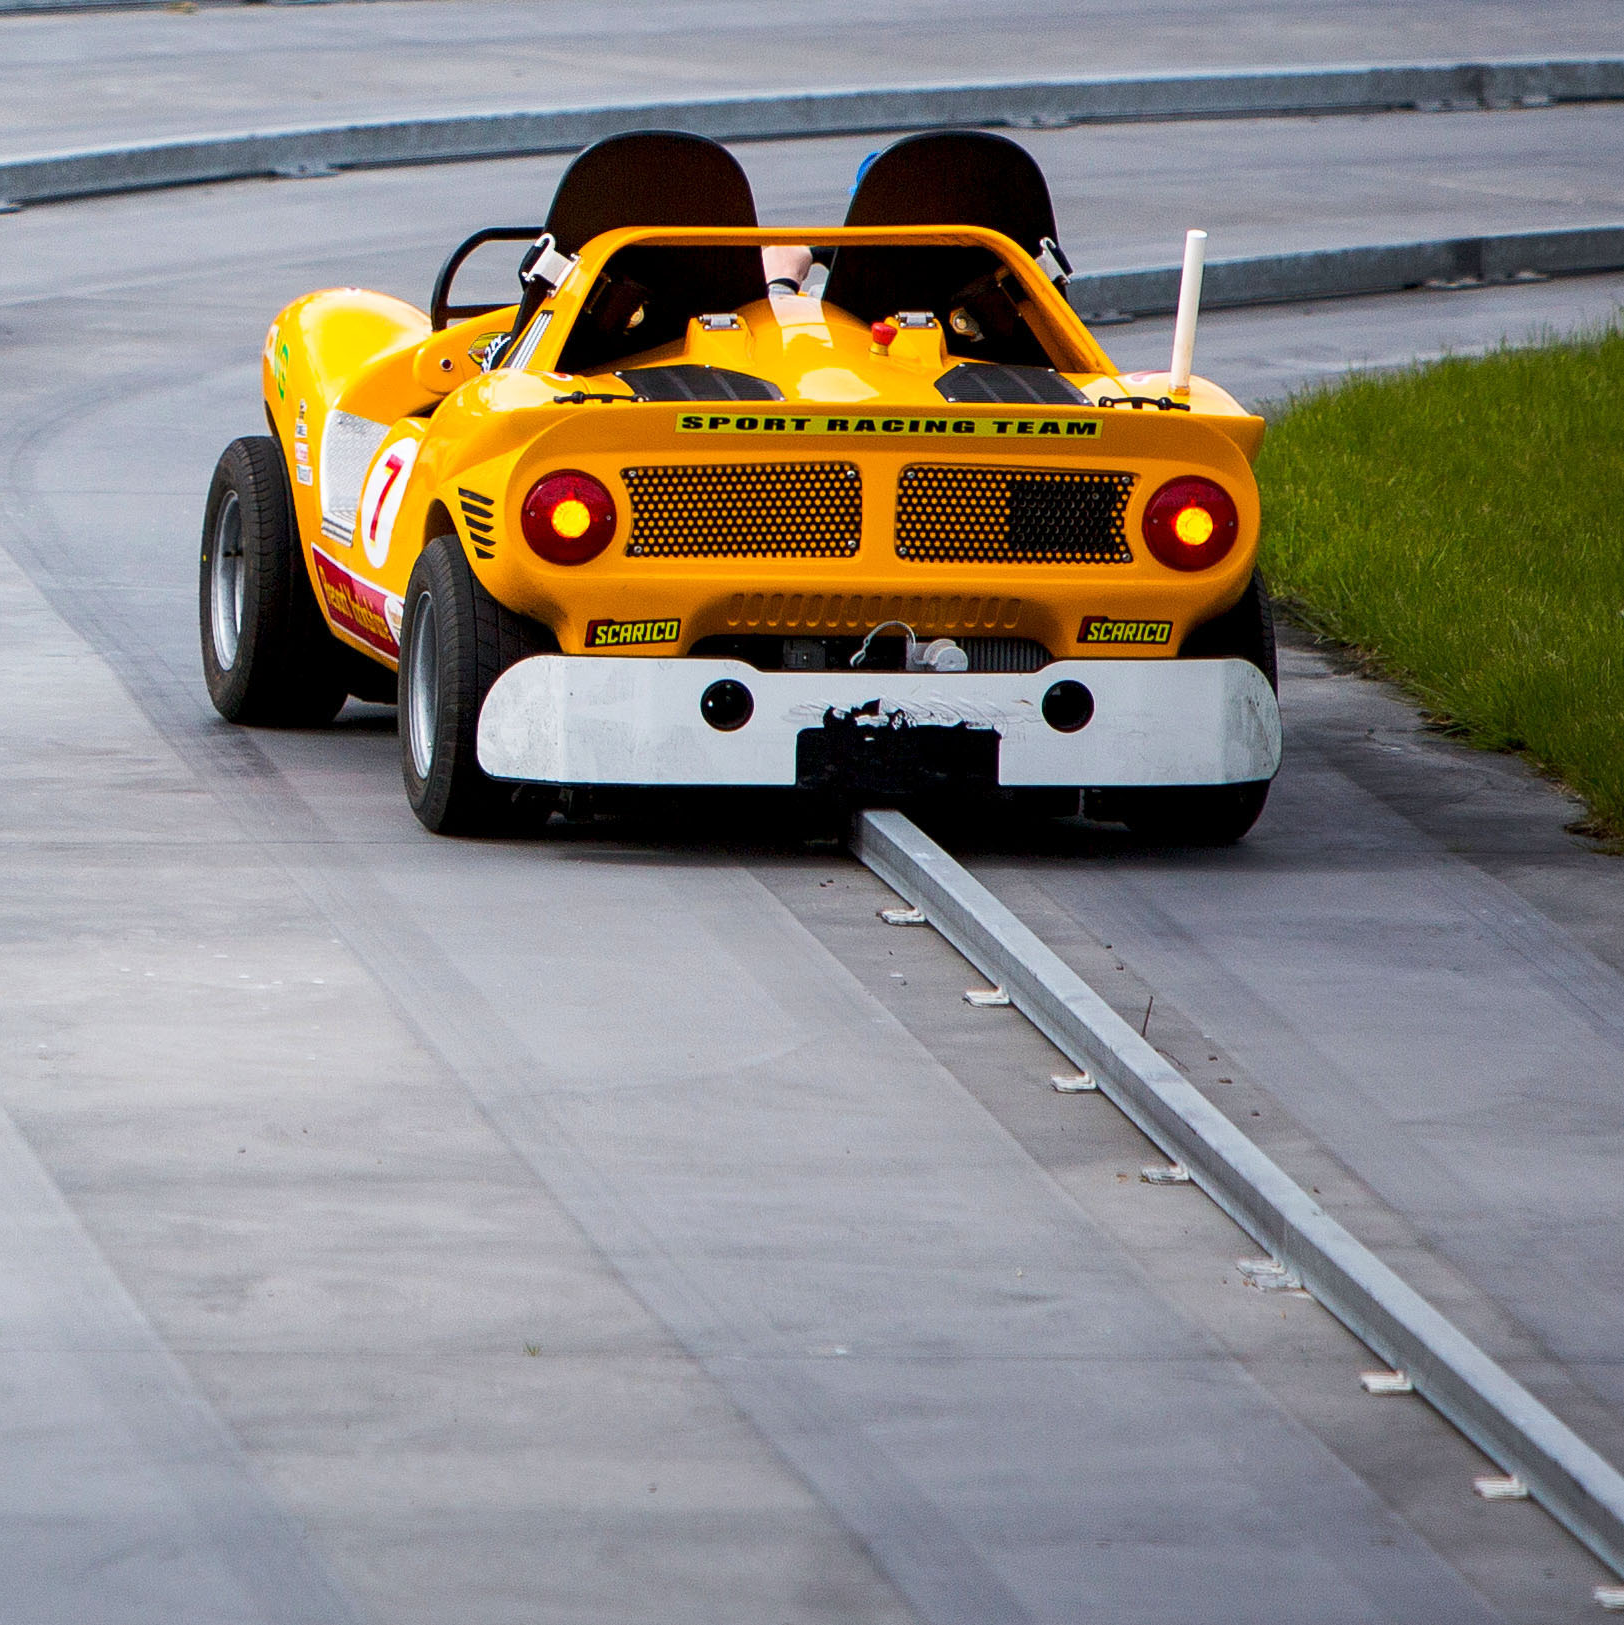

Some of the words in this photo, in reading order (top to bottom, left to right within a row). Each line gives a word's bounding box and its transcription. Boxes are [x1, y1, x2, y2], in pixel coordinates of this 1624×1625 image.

[681, 416, 812, 432] SPORT
[826, 418, 976, 434] RACING
[992, 420, 1098, 436] TEAM
[369, 452, 405, 548] 7
[595, 621, 679, 645] SCARICO
[1087, 622, 1171, 643] SCARICO
